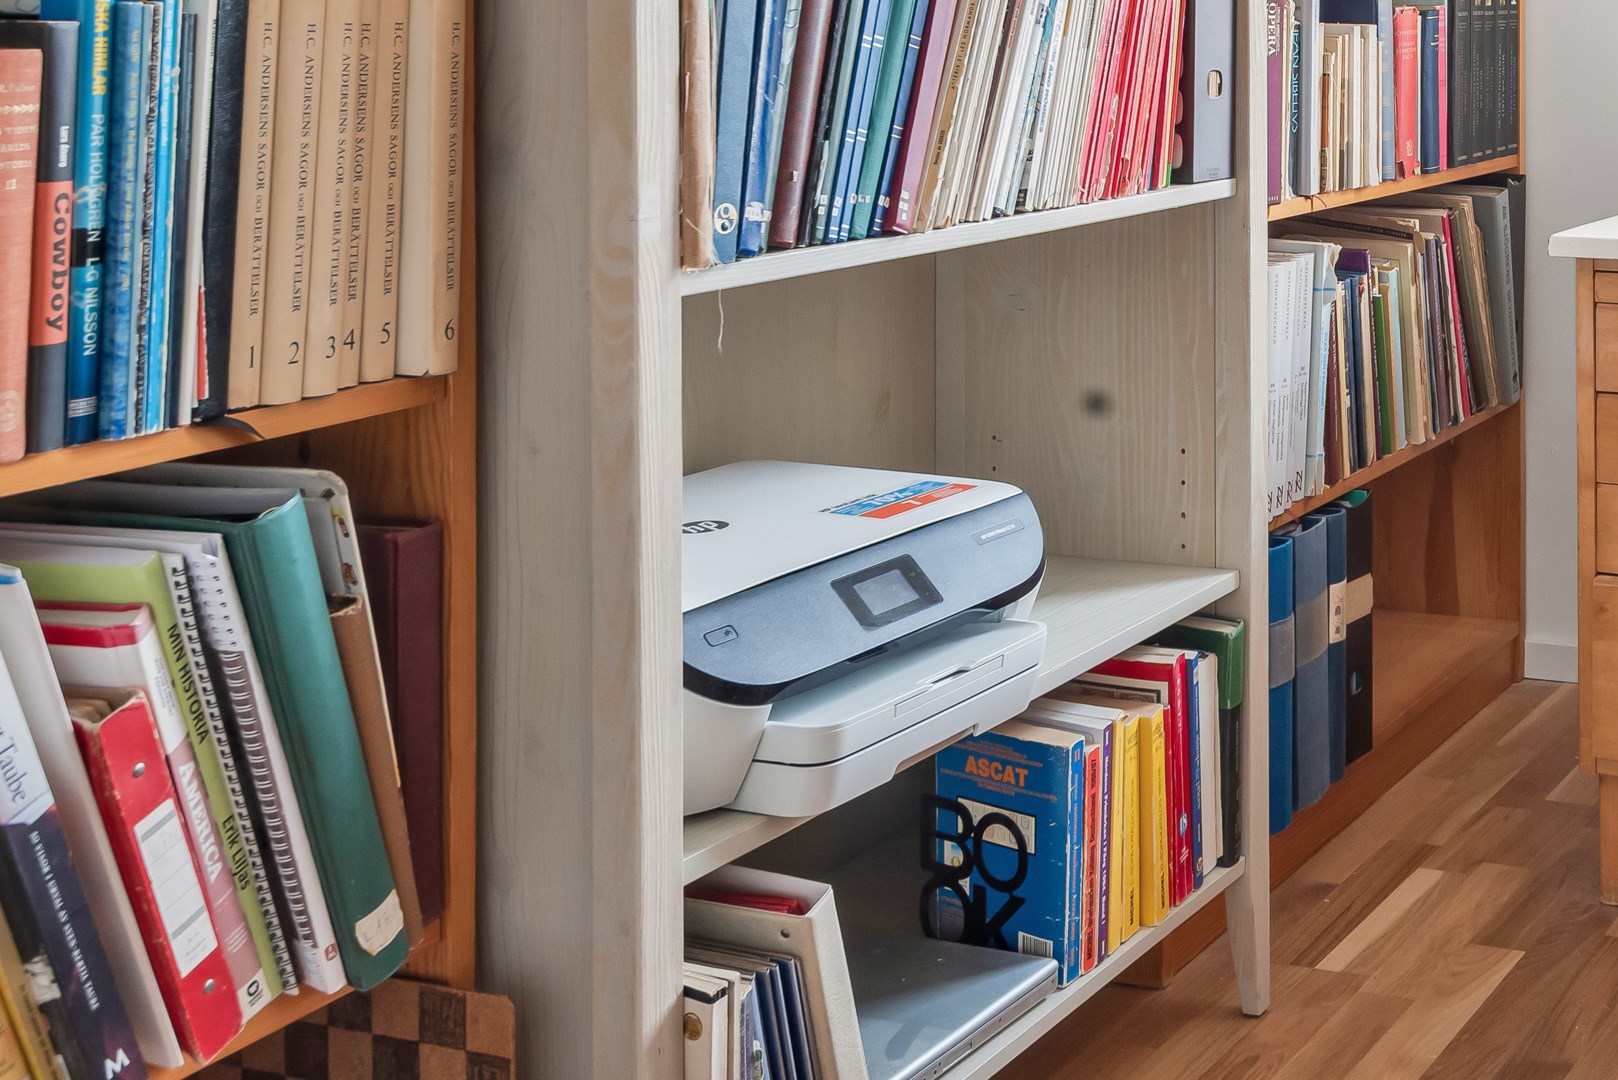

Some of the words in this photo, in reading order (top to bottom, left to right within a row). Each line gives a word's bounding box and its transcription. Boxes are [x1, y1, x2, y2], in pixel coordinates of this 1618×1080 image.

[264, 22, 272, 49] H.C.
[307, 23, 316, 50] H.C.
[344, 22, 352, 48] H.C.
[360, 22, 371, 48] H.C.
[394, 22, 404, 47] H.C.
[452, 22, 461, 47] H.C.
[962, 2, 976, 40] NORMANDS
[1267, 2, 1277, 56] OPERA
[91, 37, 108, 96] HIMLAR
[259, 54, 270, 138] ANDERSENS
[302, 55, 313, 138] ANDERSENS
[339, 53, 350, 134] ANDERSENS
[356, 52, 368, 133] ANDERSENS
[391, 51, 401, 130] ANDERSENS
[450, 51, 460, 129] ANDERSENS
[257, 142, 267, 191] SAGOR
[299, 142, 309, 190] SAGOR
[336, 138, 346, 186] SAGOR
[354, 137, 364, 183] SAGOR
[389, 134, 398, 180] SAGOR
[449, 132, 458, 177] SAGOR
[1501, 205, 1507, 220] AB
[45, 192, 70, 331] Cowboy
[83, 286, 99, 356] NILSSON
[343, 327, 356, 351] 4
[379, 322, 391, 345] 5
[444, 318, 456, 341] 6
[247, 345, 256, 369] 1
[287, 341, 300, 365] 2
[325, 336, 337, 360] 3
[167, 623, 187, 663] MIN
[178, 663, 209, 745] HISTORIA
[0, 737, 28, 803] Taube
[965, 755, 1028, 787] ASCAT
[177, 760, 225, 885] AMERICA
[221, 813, 238, 850] Erik
